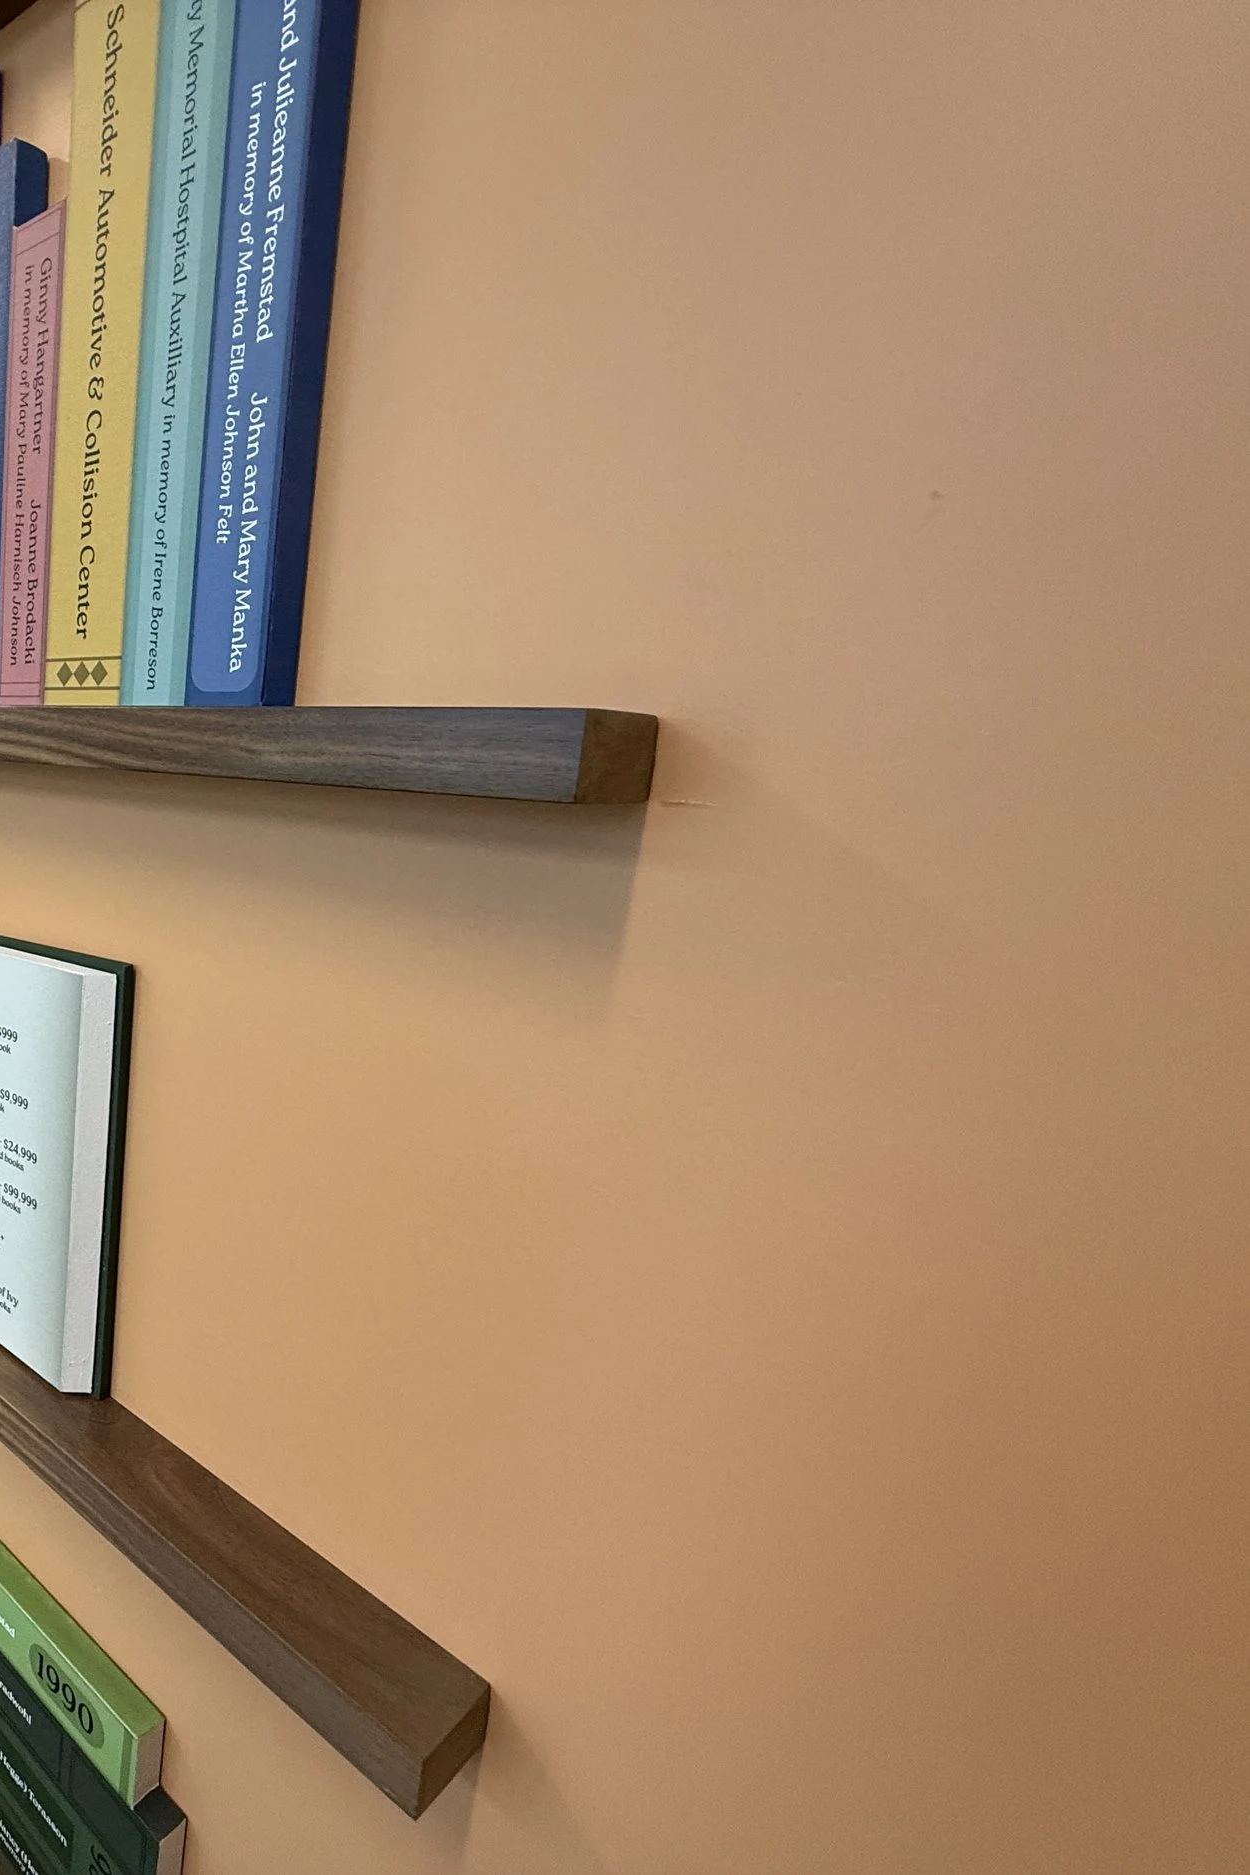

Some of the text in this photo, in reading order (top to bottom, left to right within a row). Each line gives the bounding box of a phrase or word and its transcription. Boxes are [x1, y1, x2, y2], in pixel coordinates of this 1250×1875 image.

[268, 58, 297, 202] Julieanne
[76, 4, 125, 640] Schneider Automotive & Collision Center
[216, 82, 266, 544] in memory of Martha Ellen Johnson Felt
[256, 205, 284, 343] Fremstad
[32, 257, 52, 455] Ginny Hangartner
[146, 25, 205, 691] Memorial Hostpital Auxilliary in memory of Irene Borreson
[10, 264, 35, 666] in memory of Mary Pauline Harnisch Johnson
[229, 392, 268, 673] John and Mary Manka
[24, 499, 42, 665] Joanne Brodacki
[0, 1088, 28, 1110] $9,999
[3, 1138, 38, 1165] $24,999
[4, 1152, 25, 1172] books
[1, 1194, 22, 1214] books
[3, 1182, 38, 1211] $99,999
[6, 1290, 20, 1308] Ivy
[37, 1652, 94, 1735] 1990
